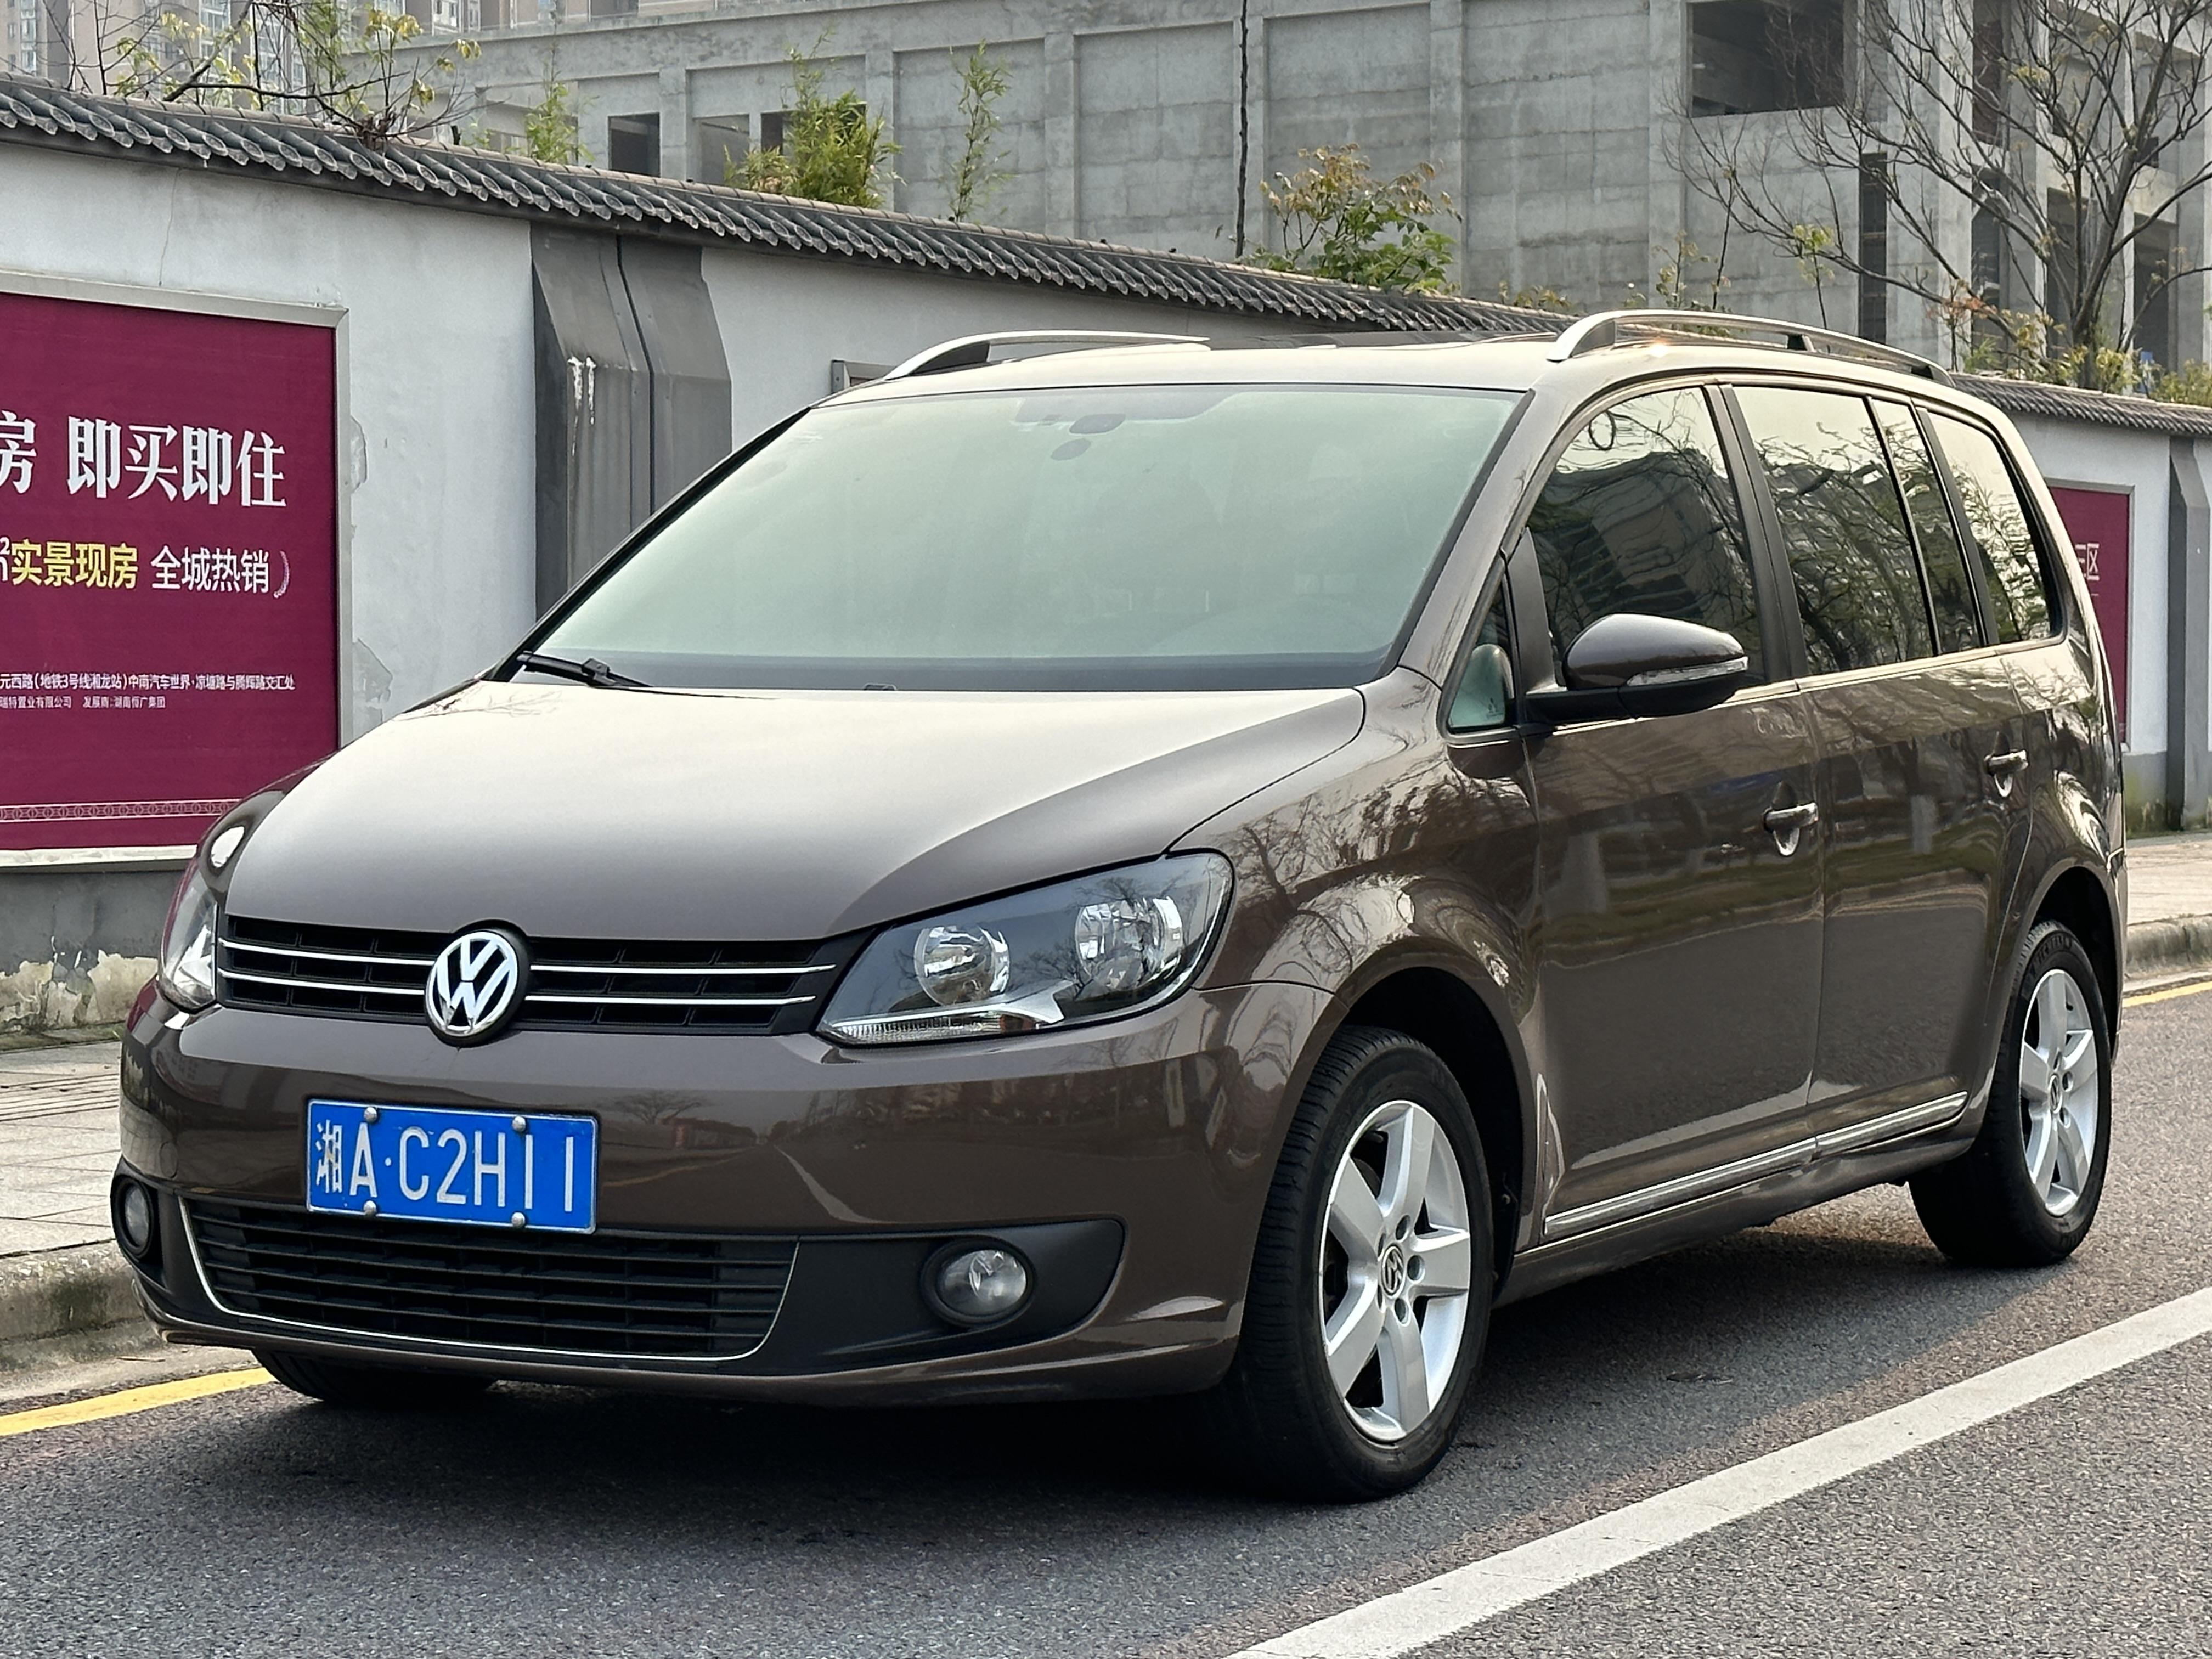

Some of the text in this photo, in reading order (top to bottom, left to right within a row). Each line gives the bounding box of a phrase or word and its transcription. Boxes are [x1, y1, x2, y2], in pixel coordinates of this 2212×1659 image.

[67, 416, 287, 507] 即买即住
[150, 545, 269, 594] 全城热销
